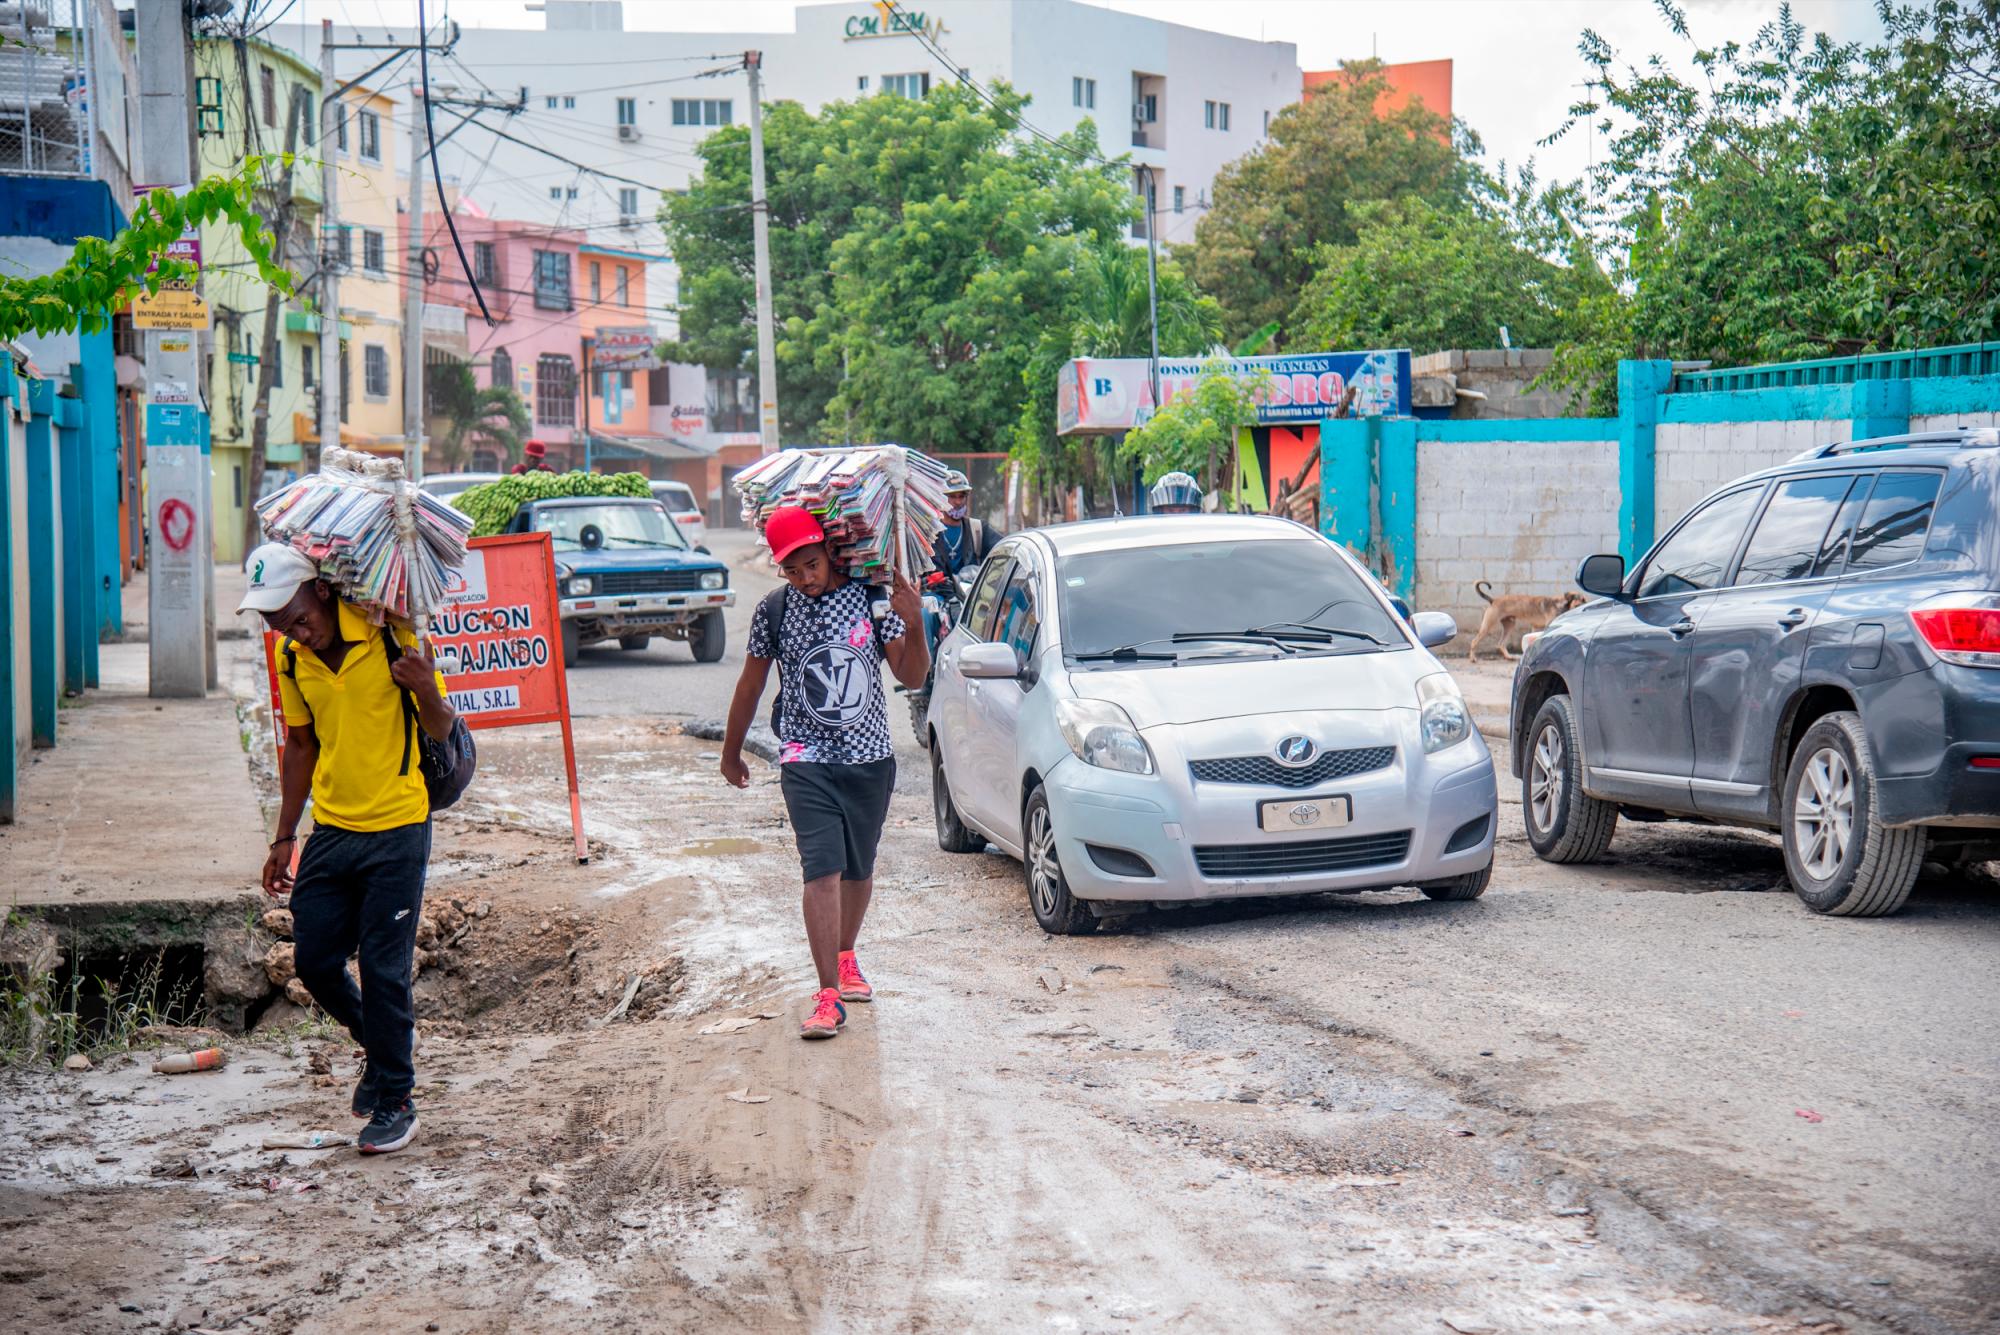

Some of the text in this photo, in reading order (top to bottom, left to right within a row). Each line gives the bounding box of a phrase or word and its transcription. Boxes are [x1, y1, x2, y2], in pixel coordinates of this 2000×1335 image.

[137, 310, 171, 318] ENTRADA
[1270, 360, 1330, 374] BANCAS
[484, 689, 516, 709] S.R.L.
